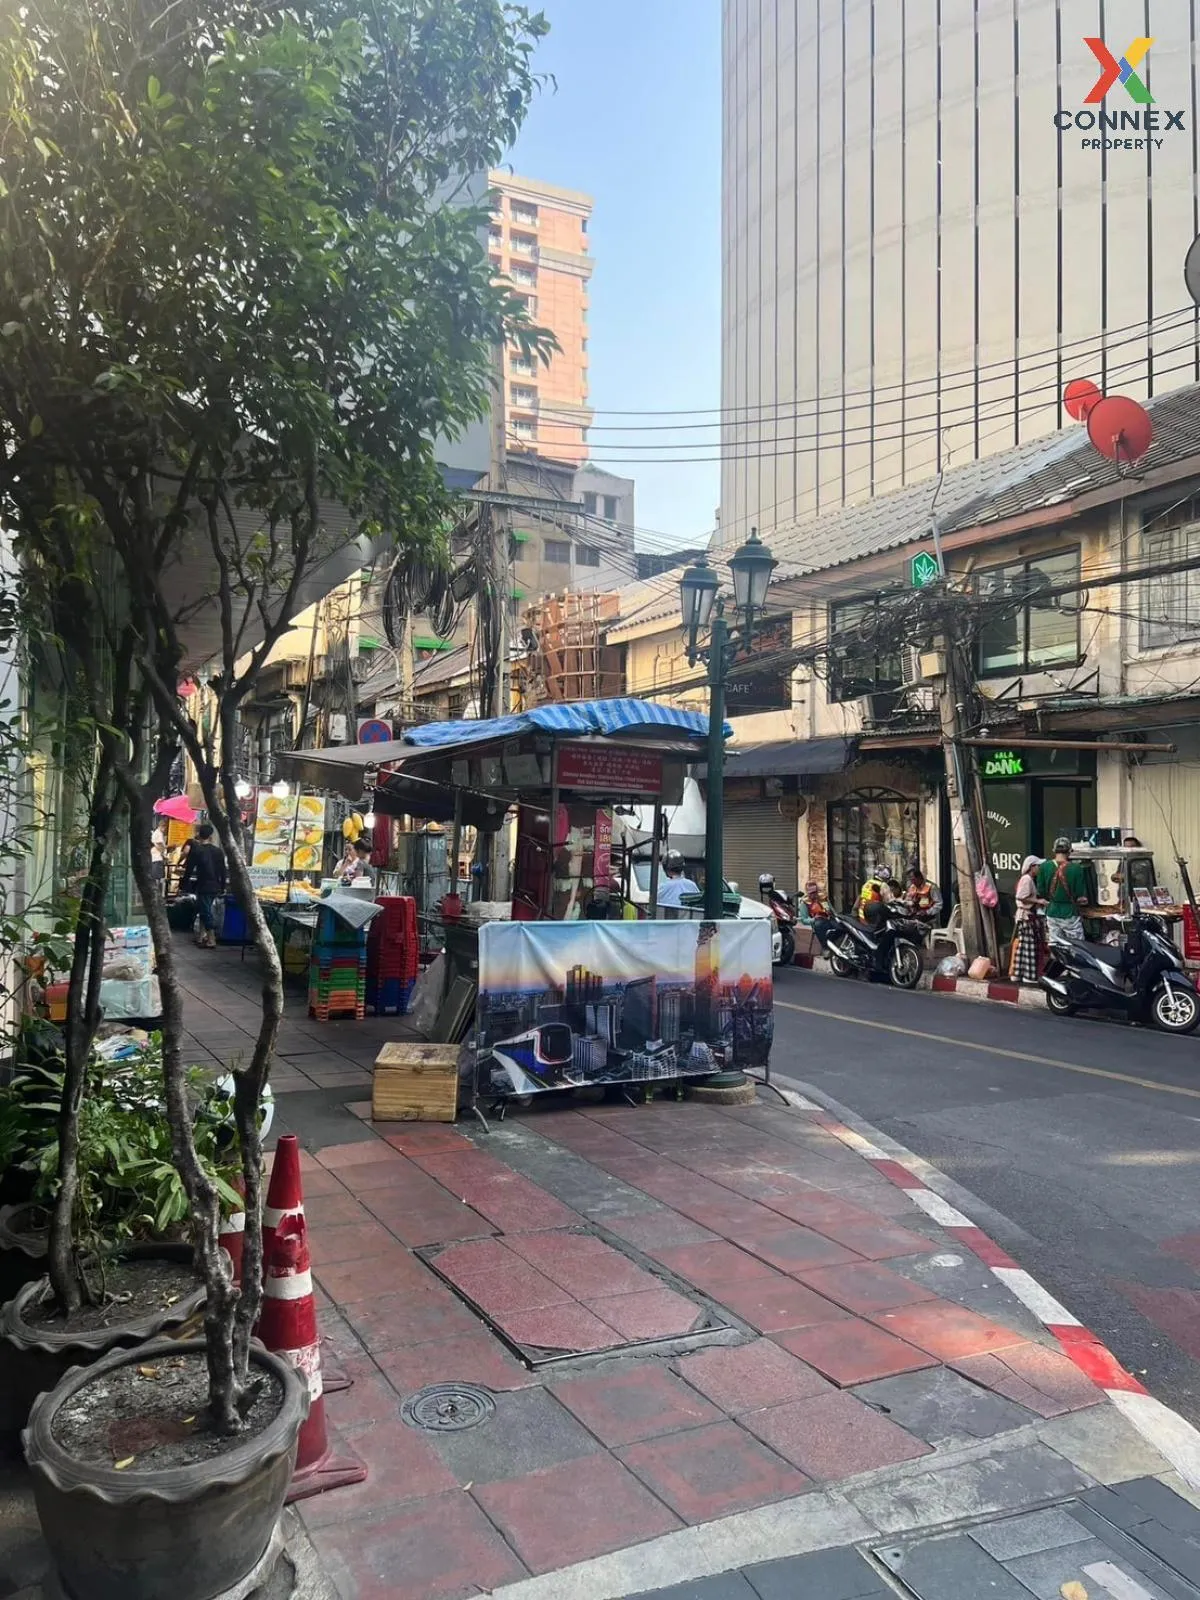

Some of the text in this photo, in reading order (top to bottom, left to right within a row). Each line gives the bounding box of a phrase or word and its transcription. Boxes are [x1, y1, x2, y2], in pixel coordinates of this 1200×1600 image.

[985, 758, 1024, 775] DANK
[986, 810, 1012, 829] UALITY
[992, 852, 1021, 871] ABIS
